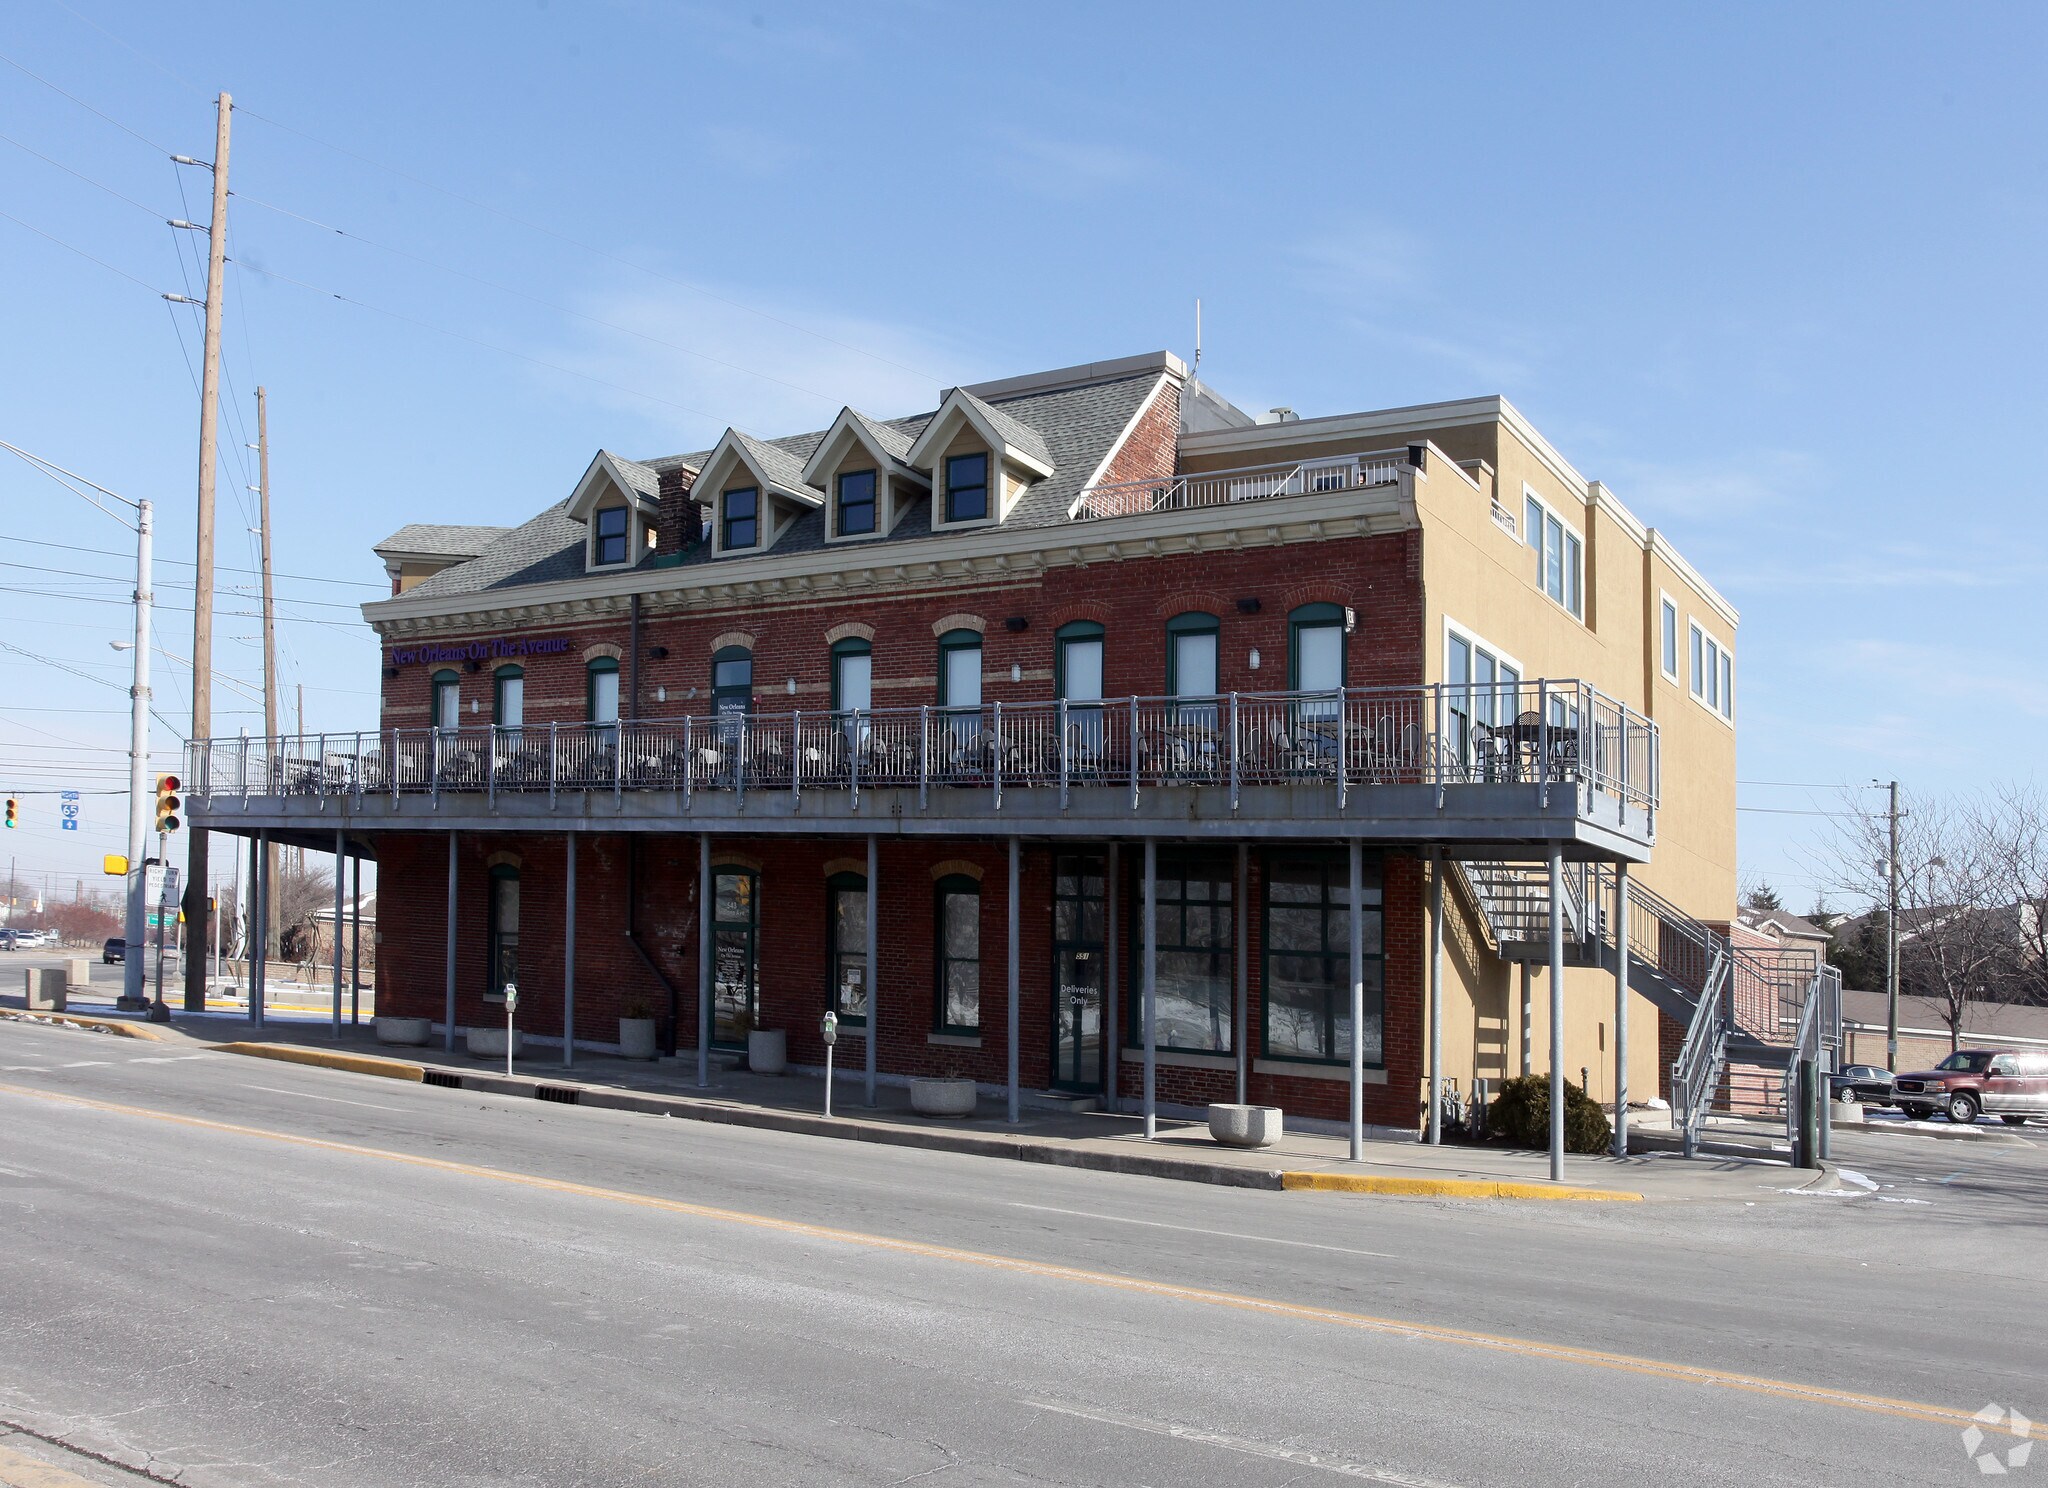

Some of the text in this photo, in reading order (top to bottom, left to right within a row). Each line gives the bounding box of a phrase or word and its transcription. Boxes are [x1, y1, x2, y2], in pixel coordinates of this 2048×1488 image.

[391, 637, 568, 665] New Orleans On The Avenue
[63, 805, 77, 816] 65
[1061, 984, 1098, 995] Deliveries
[1070, 995, 1087, 1006] Only
